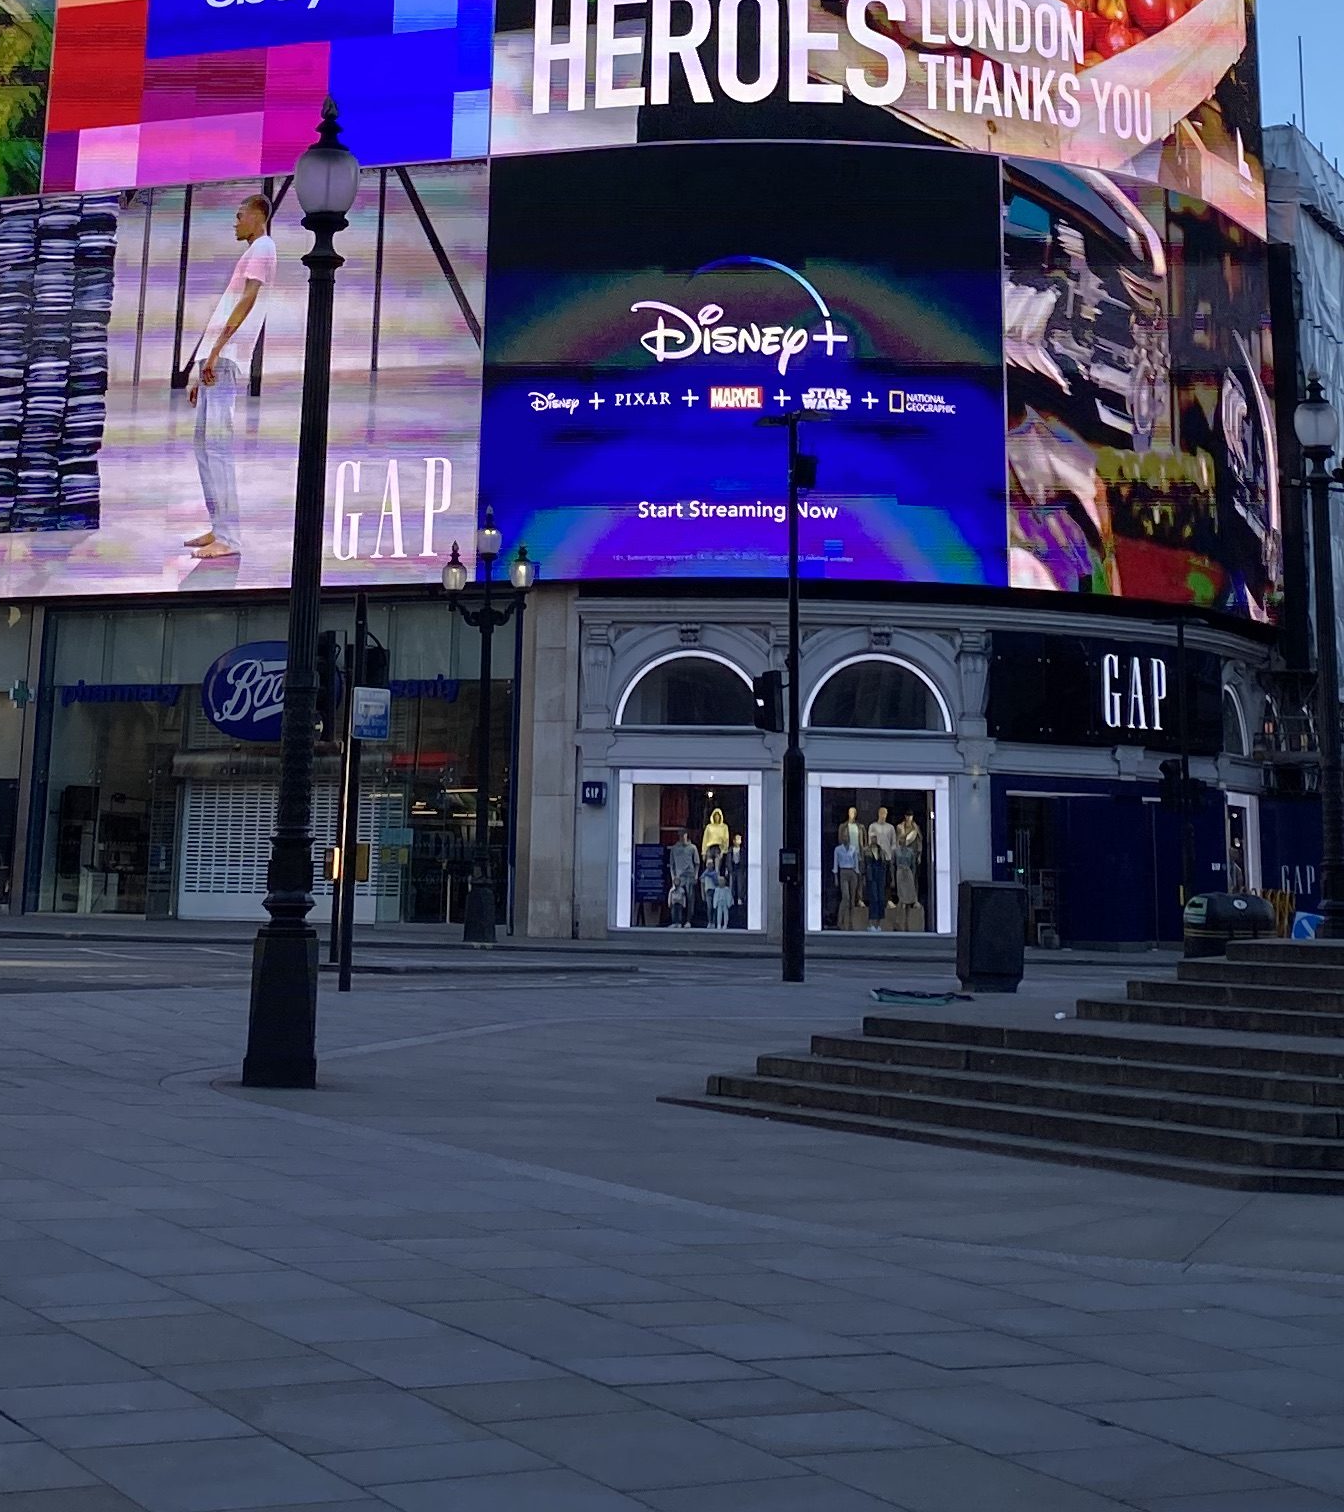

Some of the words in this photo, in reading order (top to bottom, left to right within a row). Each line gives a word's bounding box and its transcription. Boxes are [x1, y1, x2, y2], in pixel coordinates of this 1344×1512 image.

[918, 53, 1081, 128] THANKS
[1090, 76, 1153, 144] YOU
[528, 391, 580, 414] Disney
[614, 392, 672, 406] PIXAR
[711, 387, 762, 408] MARVEL
[802, 387, 850, 398] STAR
[906, 393, 946, 405] NATIONAL
[802, 398, 851, 411] WARS
[905, 402, 957, 415] GEOGRAPHIC
[331, 455, 453, 562] GAP
[638, 501, 683, 519] Start
[689, 500, 787, 522] Streaming
[796, 501, 838, 519] Now
[1101, 652, 1167, 731] GAP
[1281, 864, 1316, 895] GAP
